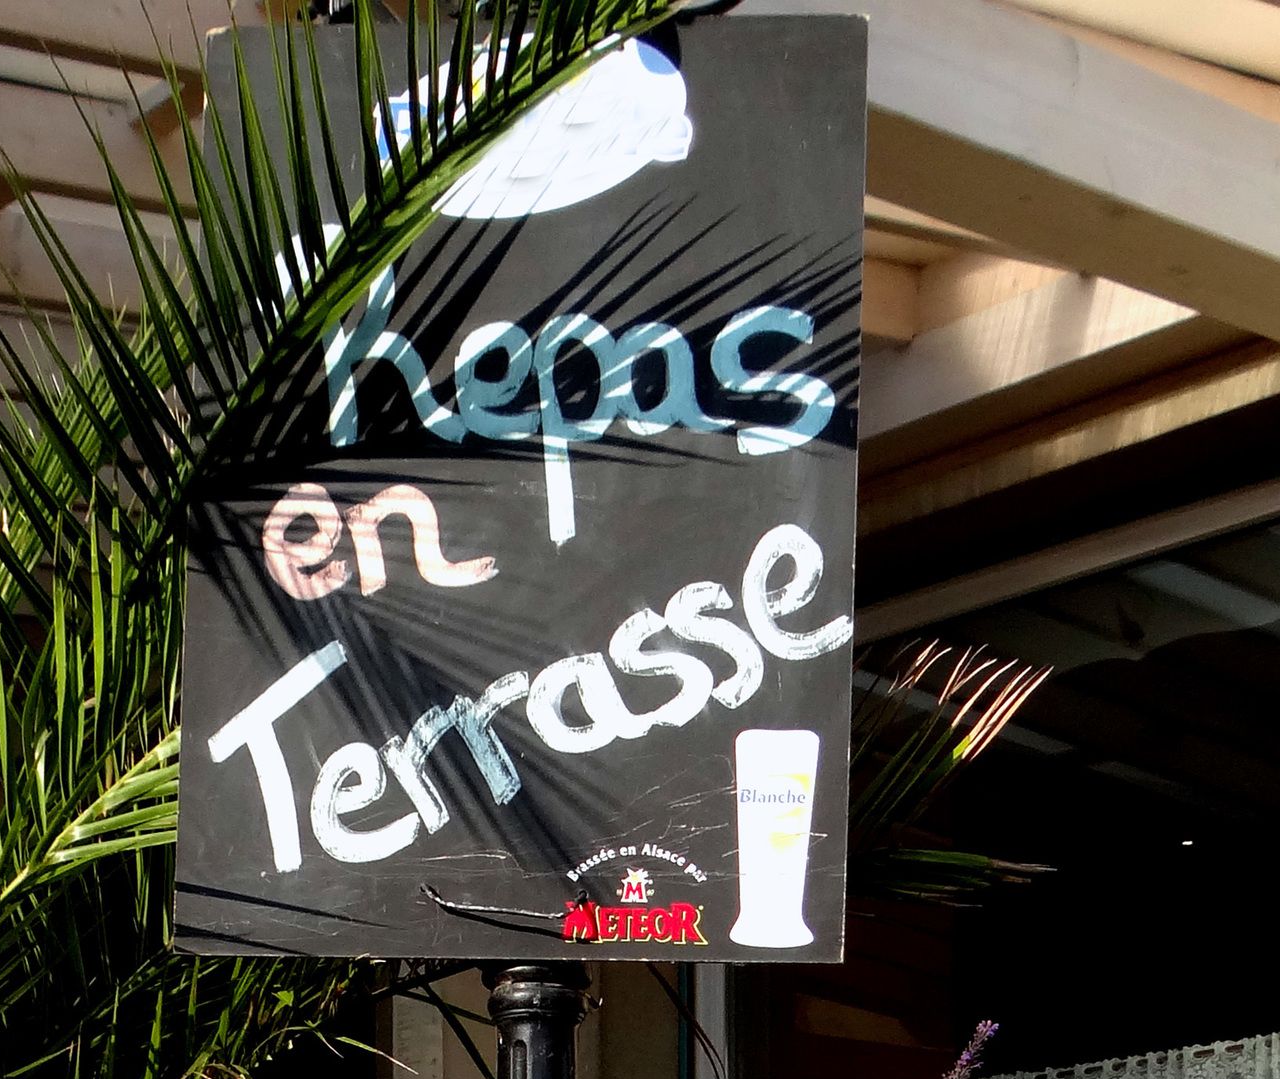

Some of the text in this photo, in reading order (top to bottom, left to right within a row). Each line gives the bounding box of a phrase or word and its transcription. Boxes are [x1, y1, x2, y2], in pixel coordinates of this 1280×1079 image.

[261, 482, 500, 601] en
[207, 523, 853, 873] Terrasse
[739, 787, 807, 804] Blanche
[566, 843, 708, 884] Brassée en Alsace par
[563, 901, 709, 946] METEOR
